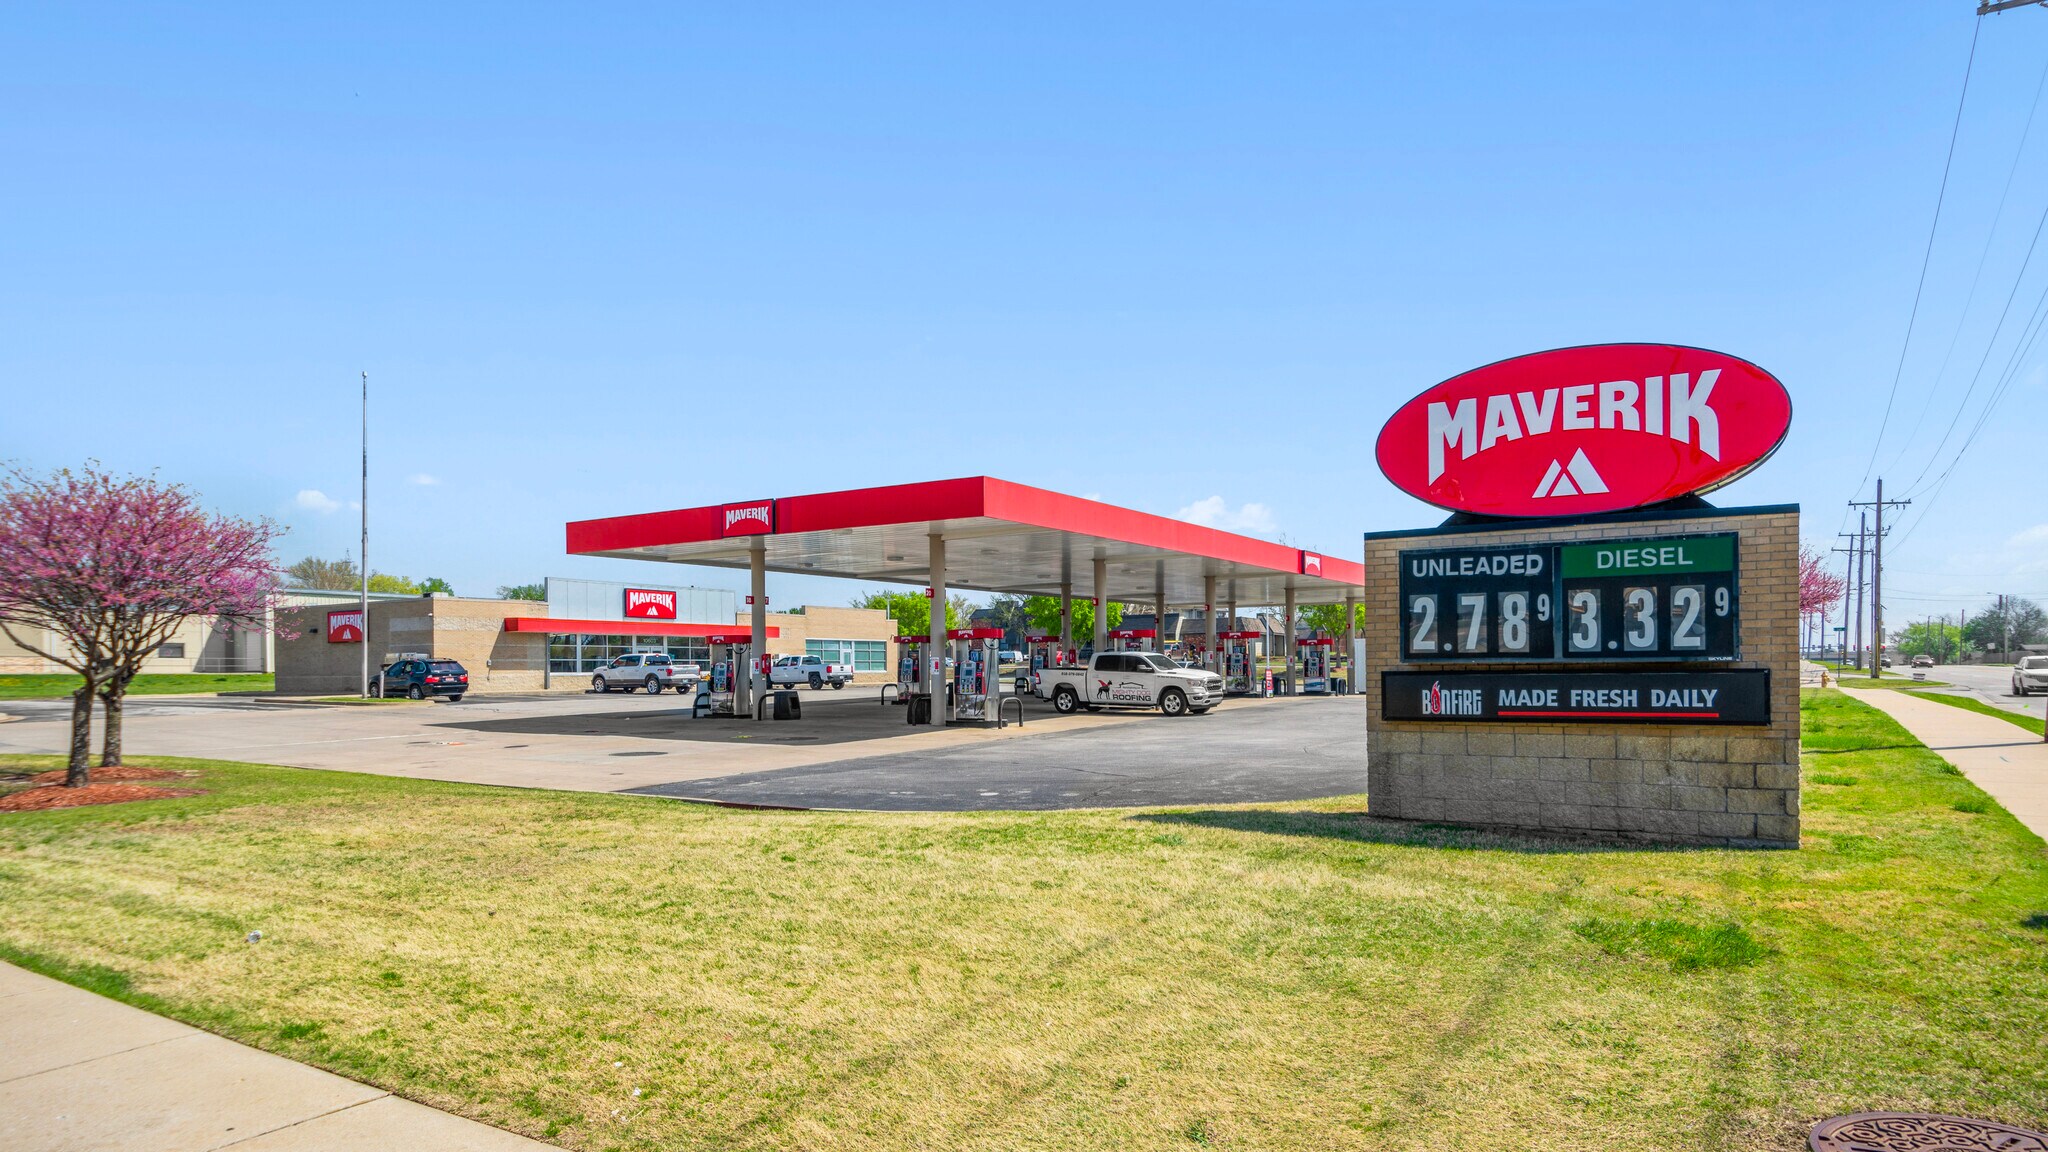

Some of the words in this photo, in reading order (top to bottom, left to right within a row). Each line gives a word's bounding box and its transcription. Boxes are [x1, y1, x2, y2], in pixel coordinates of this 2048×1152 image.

[1428, 369, 1722, 487] MAVERIK
[726, 506, 769, 530] MAVERIK
[1412, 554, 1543, 577] UNLEADED
[1597, 547, 1693, 569] DIESEL
[629, 591, 673, 612] MAVERIK
[330, 614, 363, 634] MAVERIK
[1499, 689, 1558, 707] MADE
[1570, 689, 1637, 708] FRESH
[1651, 688, 1718, 708] DAILY
